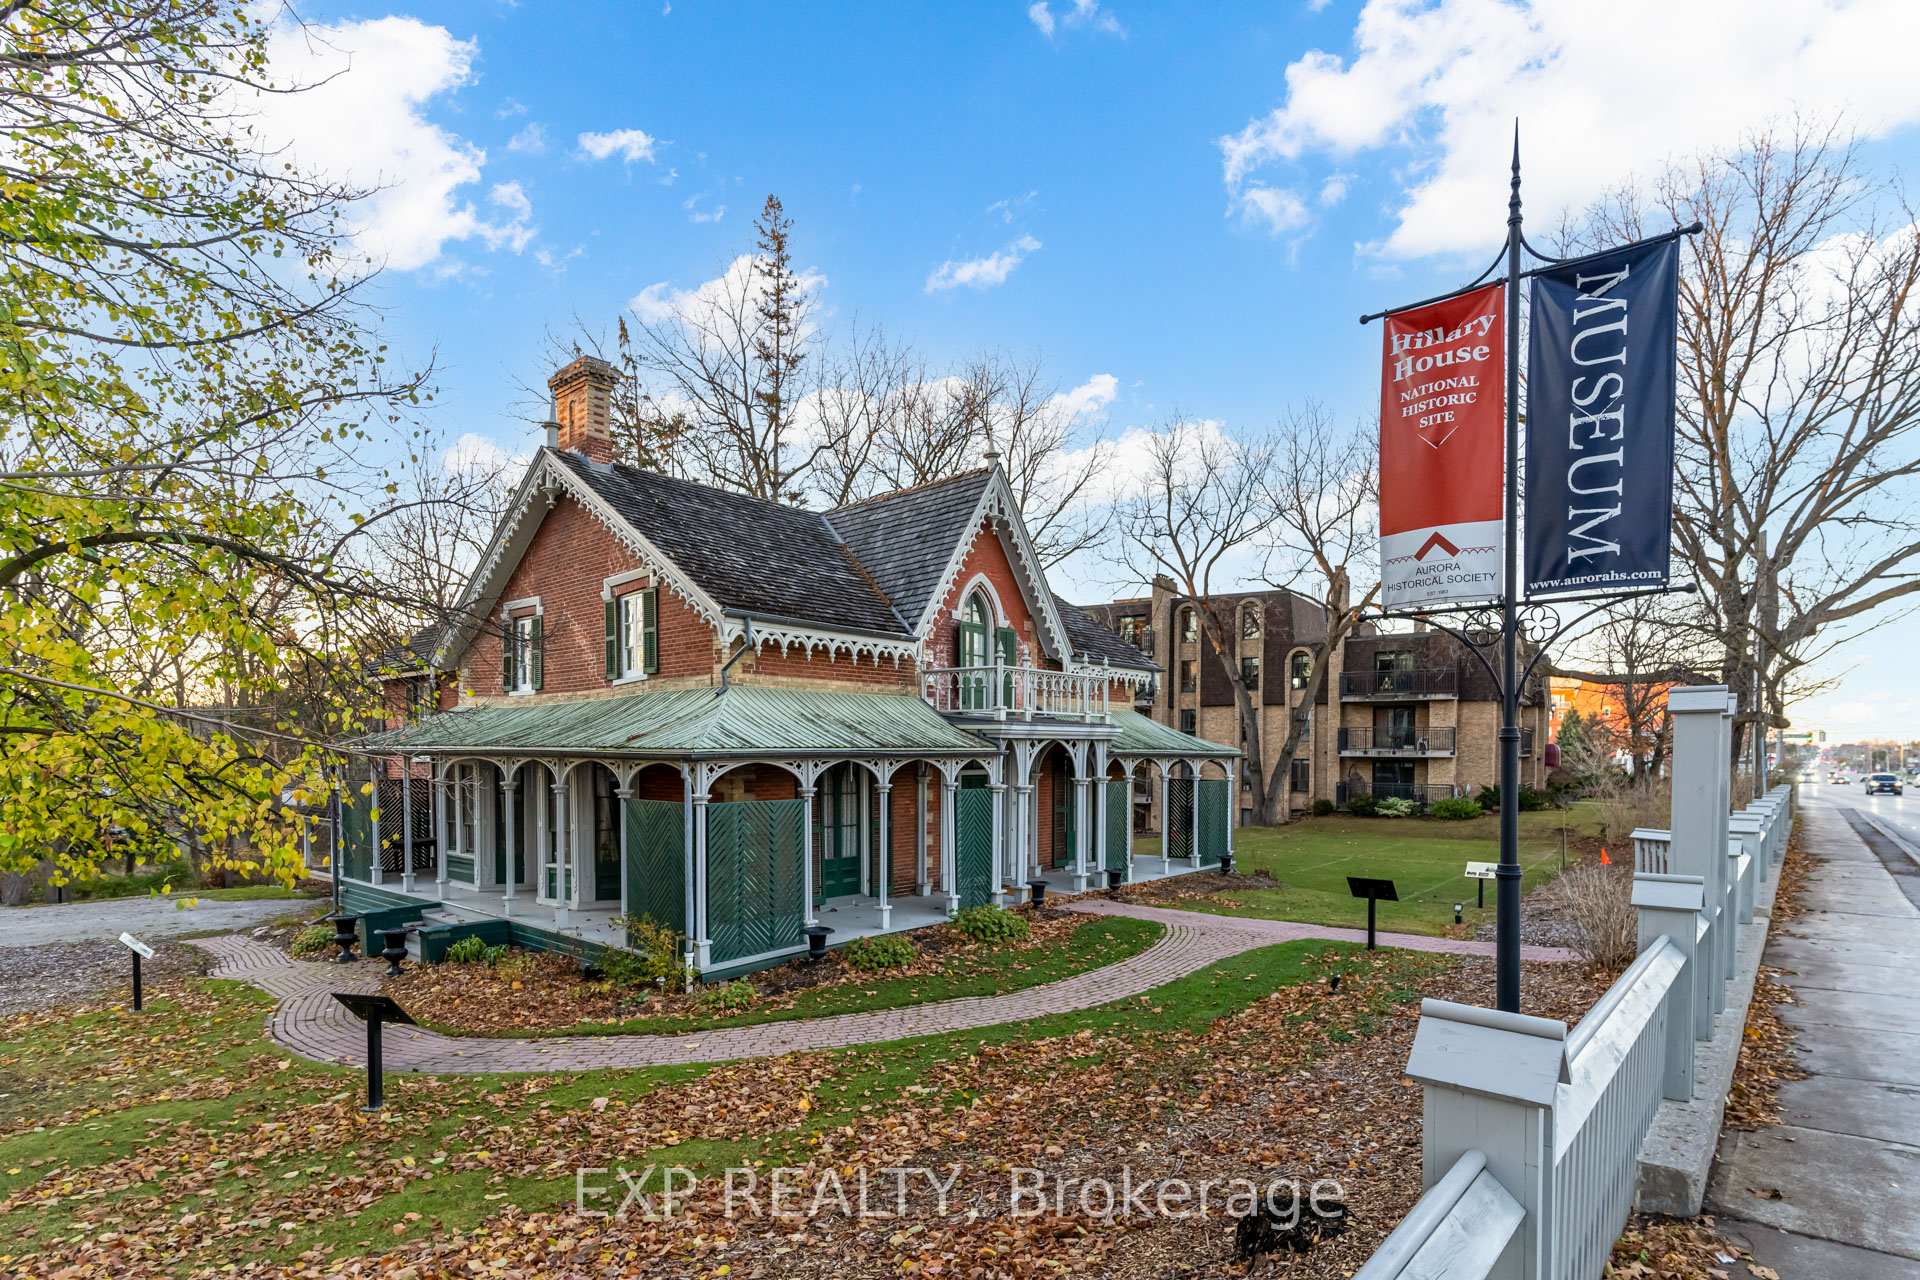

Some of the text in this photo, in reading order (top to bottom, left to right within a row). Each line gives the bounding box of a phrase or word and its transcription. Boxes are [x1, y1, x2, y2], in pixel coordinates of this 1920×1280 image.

[1389, 313, 1497, 356] Hillary
[1392, 344, 1490, 383] House
[1400, 375, 1480, 402] NATIONAL
[1401, 392, 1477, 418] HISTORIC
[1567, 263, 1630, 564] MUSEUM
[1419, 410, 1455, 429] SITE
[1415, 562, 1461, 576] AURORA
[1529, 569, 1662, 590] www.aurorahs.com
[1387, 572, 1496, 593] HISTORICAL SOCIETY
